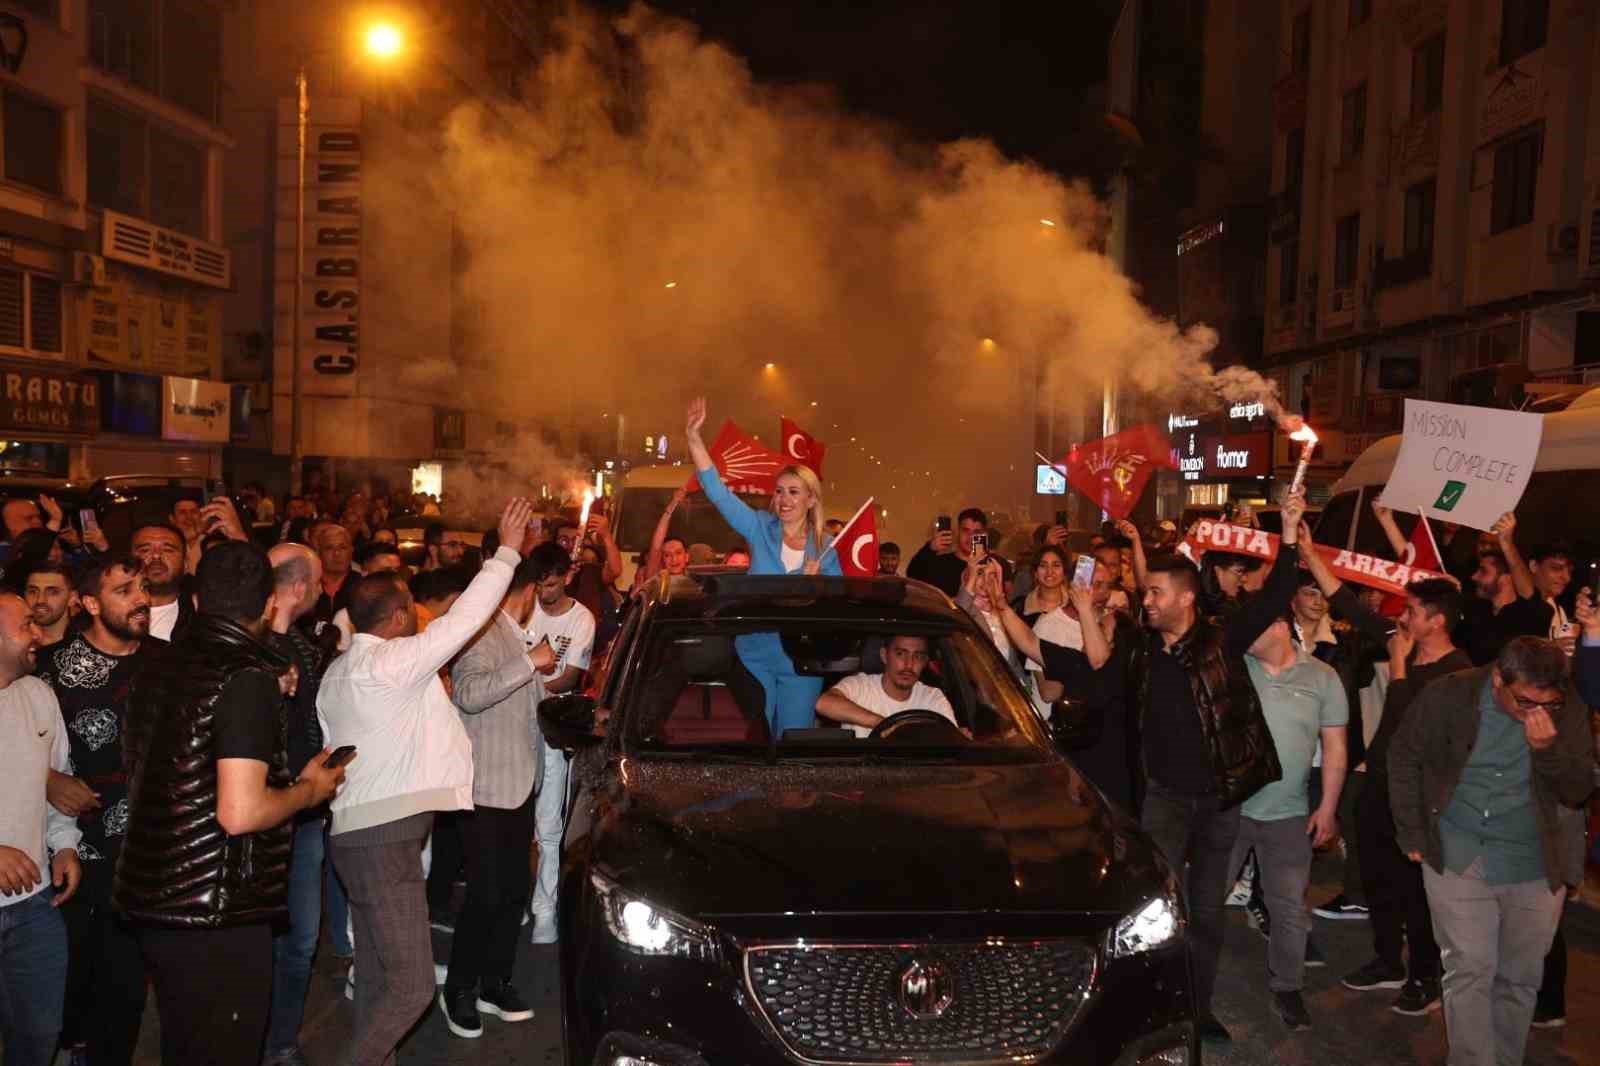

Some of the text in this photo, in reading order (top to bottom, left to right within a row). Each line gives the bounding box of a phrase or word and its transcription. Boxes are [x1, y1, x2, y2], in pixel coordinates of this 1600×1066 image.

[1410, 411, 1468, 440] MISSION
[1432, 446, 1519, 484] COMPLETE
[1196, 520, 1271, 556] POTA
